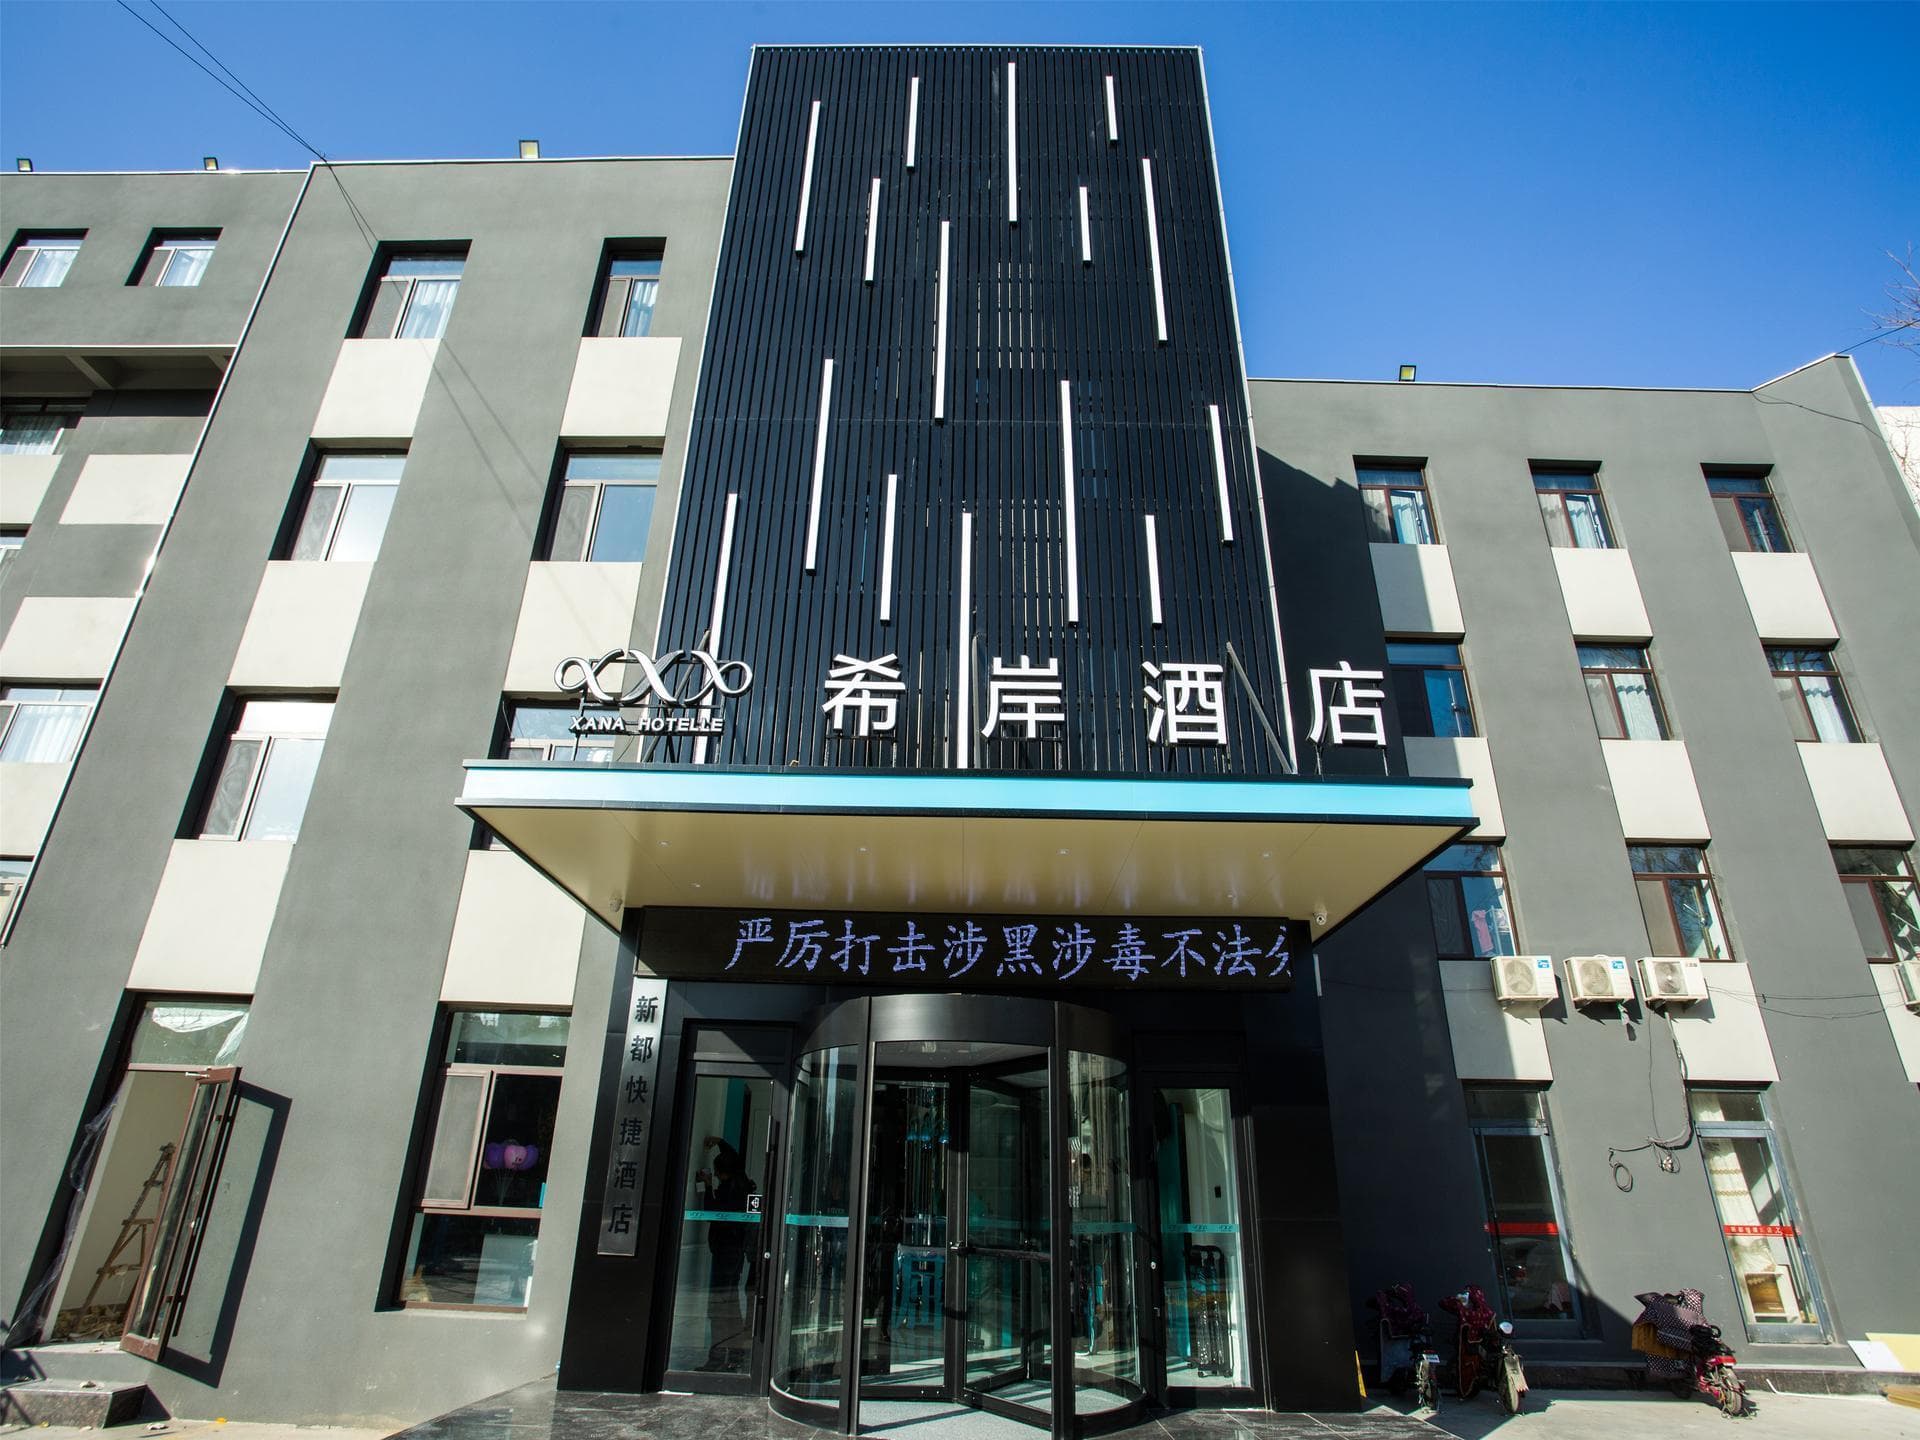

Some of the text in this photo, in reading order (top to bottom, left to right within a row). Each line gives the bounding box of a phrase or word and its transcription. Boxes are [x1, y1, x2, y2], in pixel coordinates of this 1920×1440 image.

[570, 716, 724, 732] XANA HOTELLE
[821, 653, 1387, 746] 希岸酒店
[607, 995, 659, 1235] 新都快捷酒店
